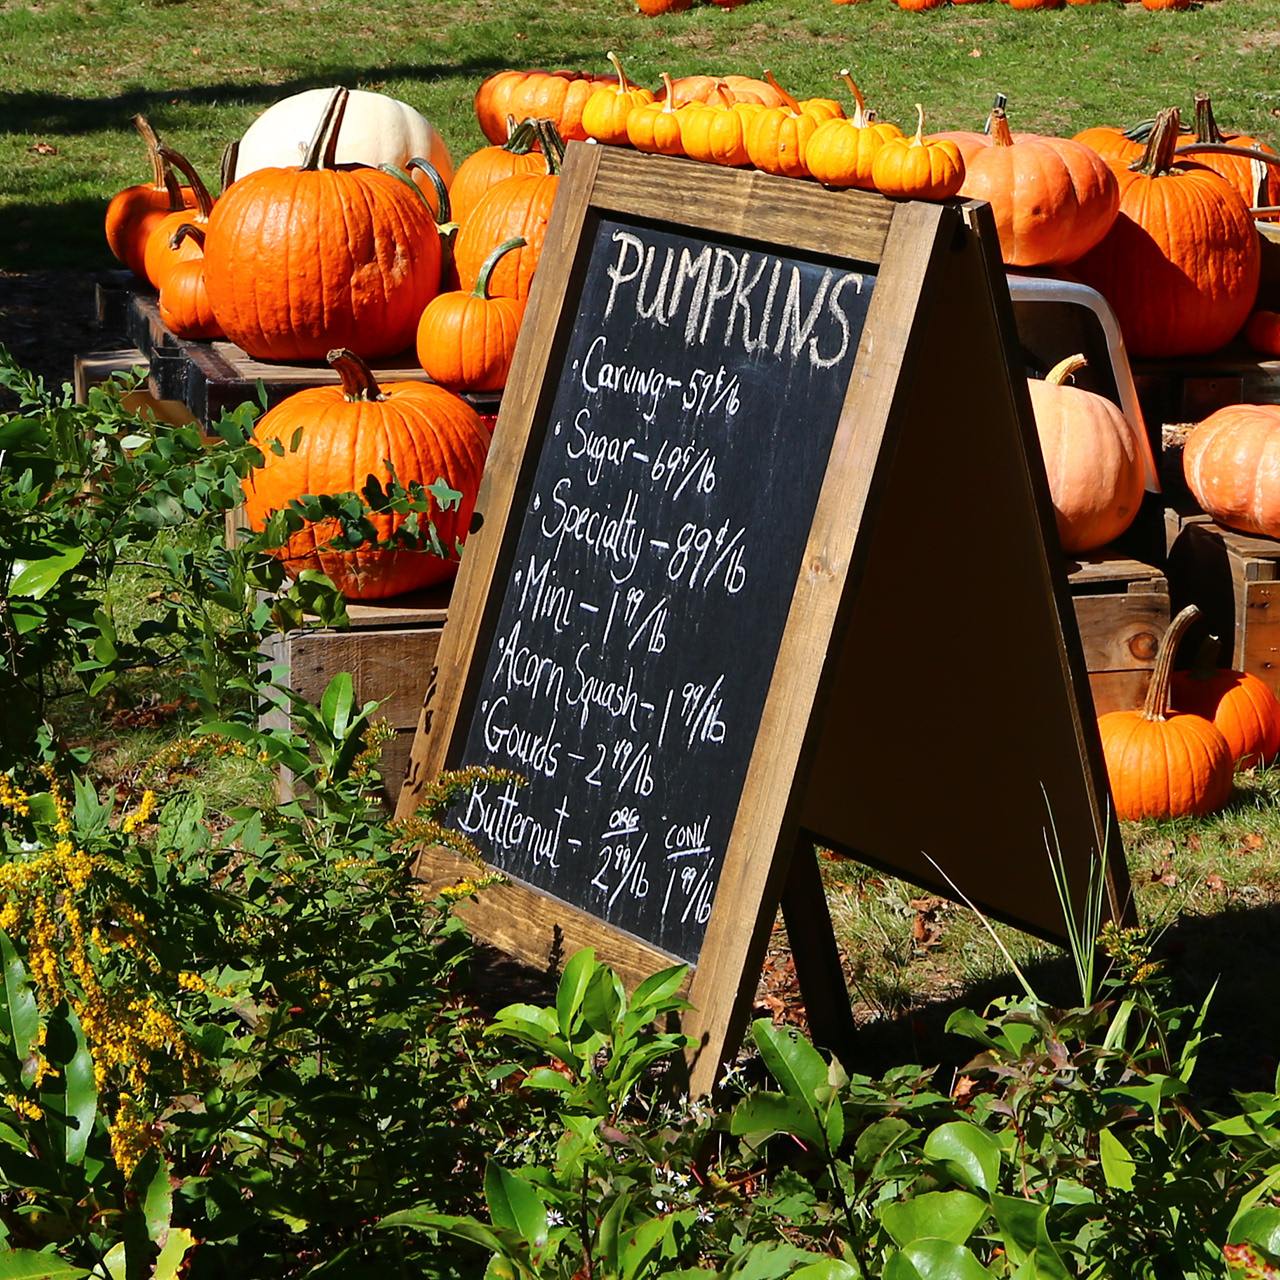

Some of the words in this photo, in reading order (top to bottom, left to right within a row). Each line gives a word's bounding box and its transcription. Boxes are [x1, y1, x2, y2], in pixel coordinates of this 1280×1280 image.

[605, 229, 864, 368] PUMPKINS
[582, 336, 665, 421] Carving
[567, 408, 635, 486] Sugar
[541, 477, 645, 584] Specialty
[519, 554, 579, 632] Mini
[492, 620, 564, 712] Acorn
[566, 643, 637, 732] Squash
[484, 696, 562, 777] Gourds
[457, 768, 570, 869] Butternut
[609, 806, 640, 829] ORG
[665, 815, 711, 850] CONV
